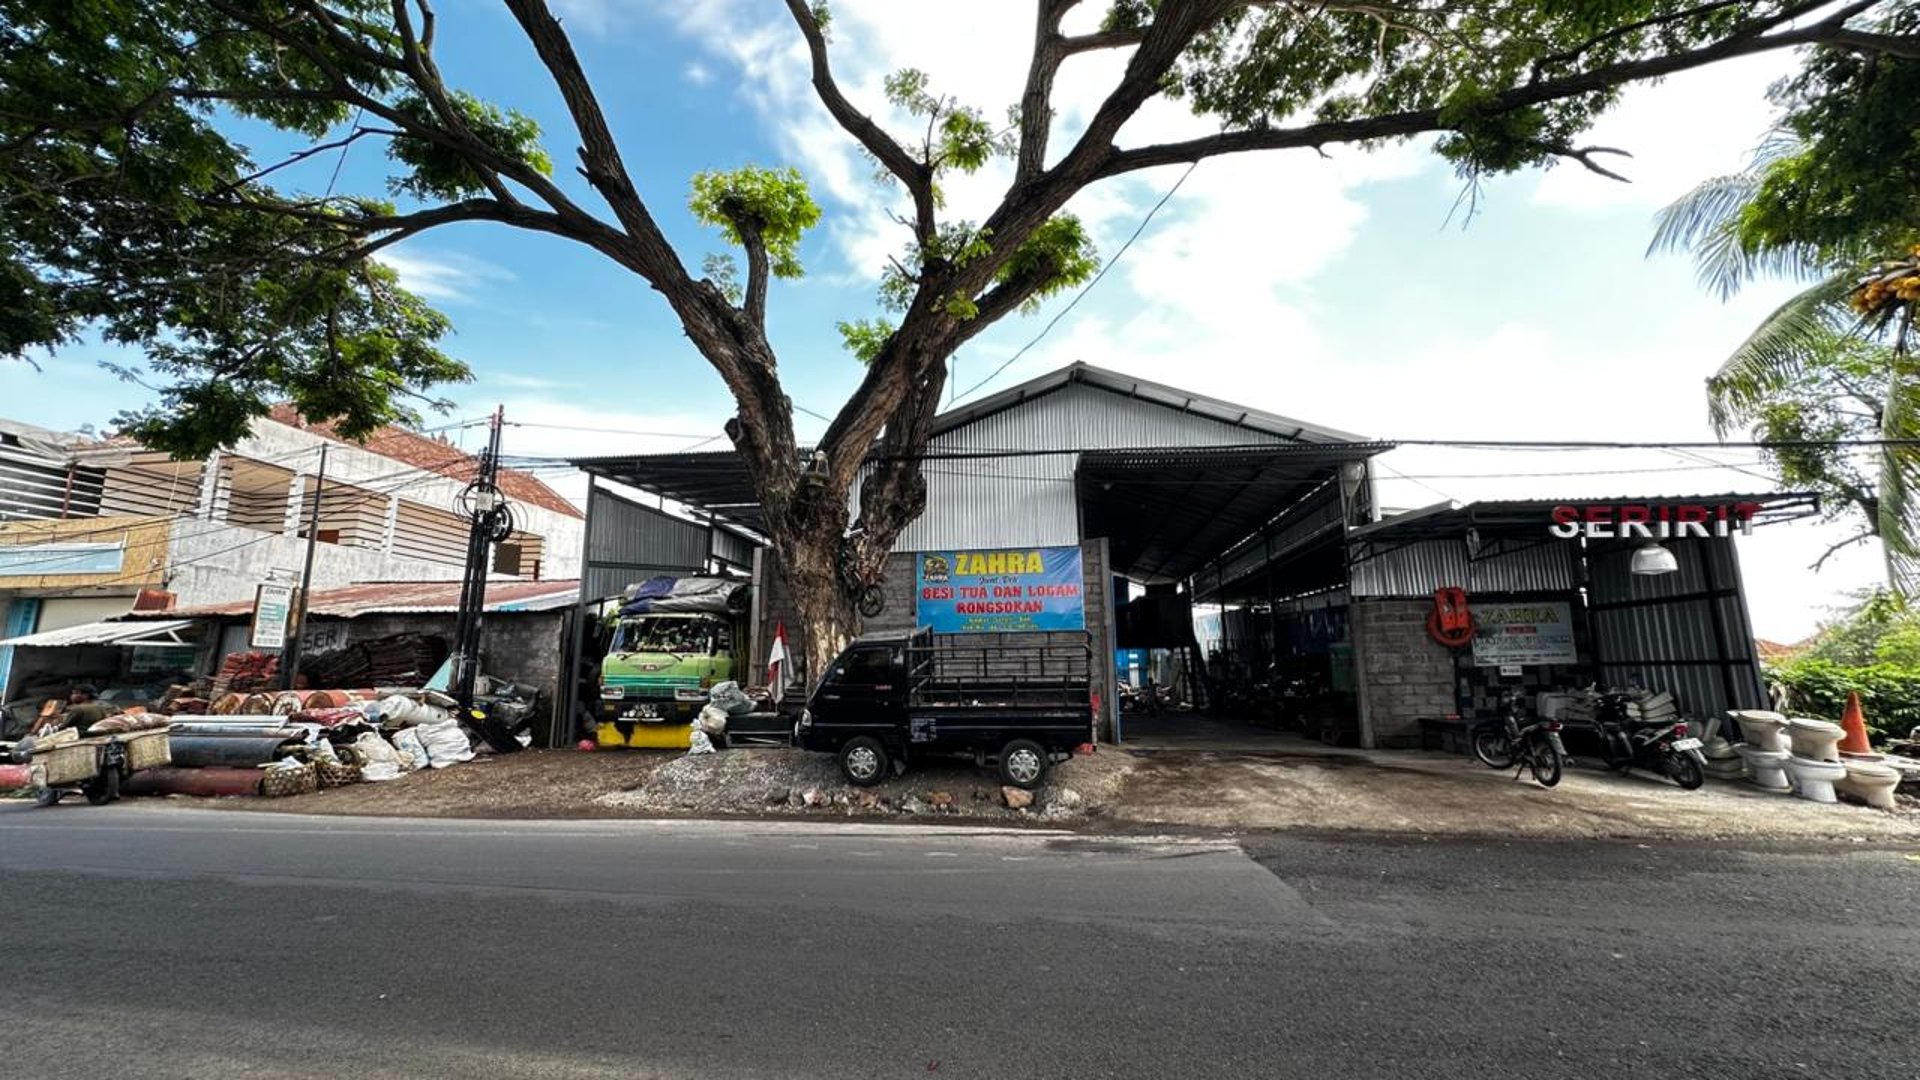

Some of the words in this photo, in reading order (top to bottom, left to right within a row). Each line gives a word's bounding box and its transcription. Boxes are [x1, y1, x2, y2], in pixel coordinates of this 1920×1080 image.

[1549, 502, 1762, 538] SERIRIT
[955, 551, 1044, 576] ZAHRA
[922, 587, 955, 600] BESI
[960, 586, 988, 599] TUA
[993, 585, 1022, 598] DAN
[1028, 584, 1079, 598] LOGAM
[956, 601, 1044, 614] RONGSOKAN
